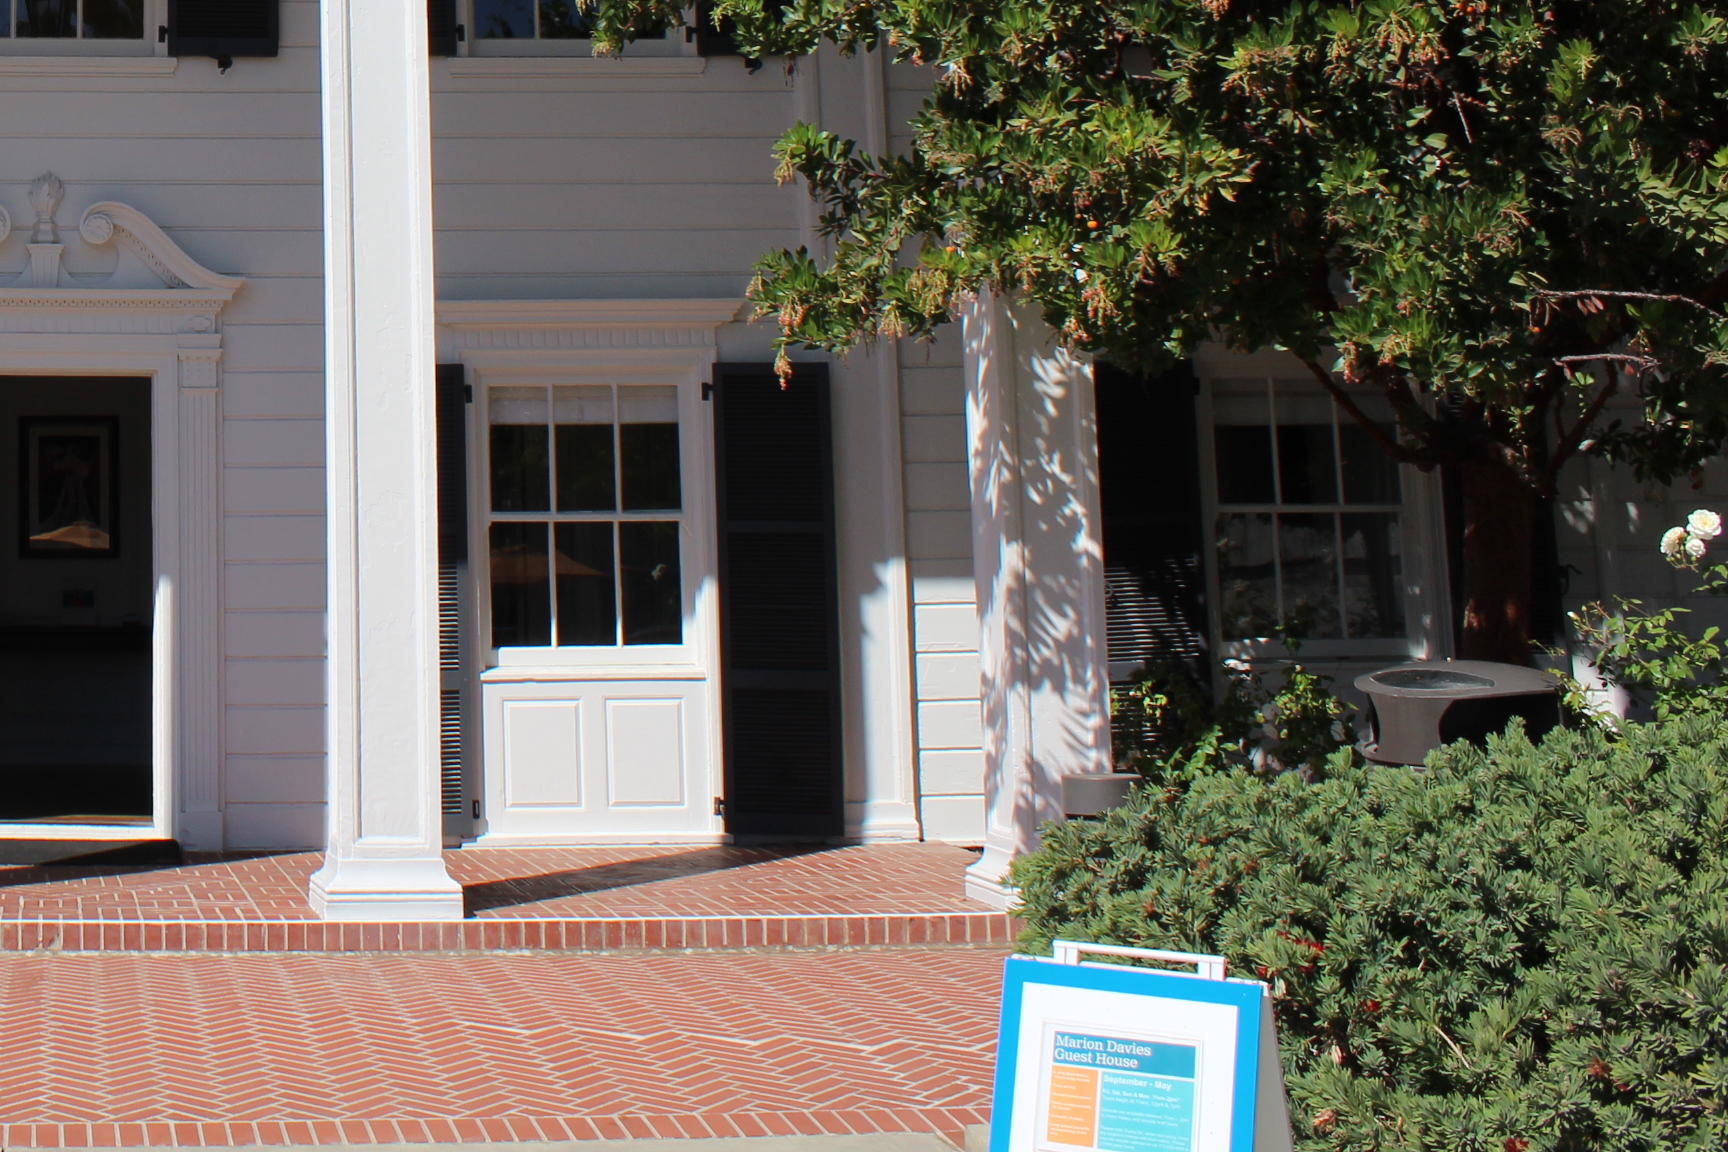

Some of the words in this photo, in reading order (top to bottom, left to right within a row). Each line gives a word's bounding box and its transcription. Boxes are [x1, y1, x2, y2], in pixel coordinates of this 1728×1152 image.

[1056, 1035, 1104, 1052] Marion
[1107, 1040, 1152, 1057] Davies
[1054, 1048, 1094, 1064] Guest
[1096, 1052, 1139, 1068] House
[1104, 1074, 1147, 1088] September
[1154, 1080, 1172, 1092] May
